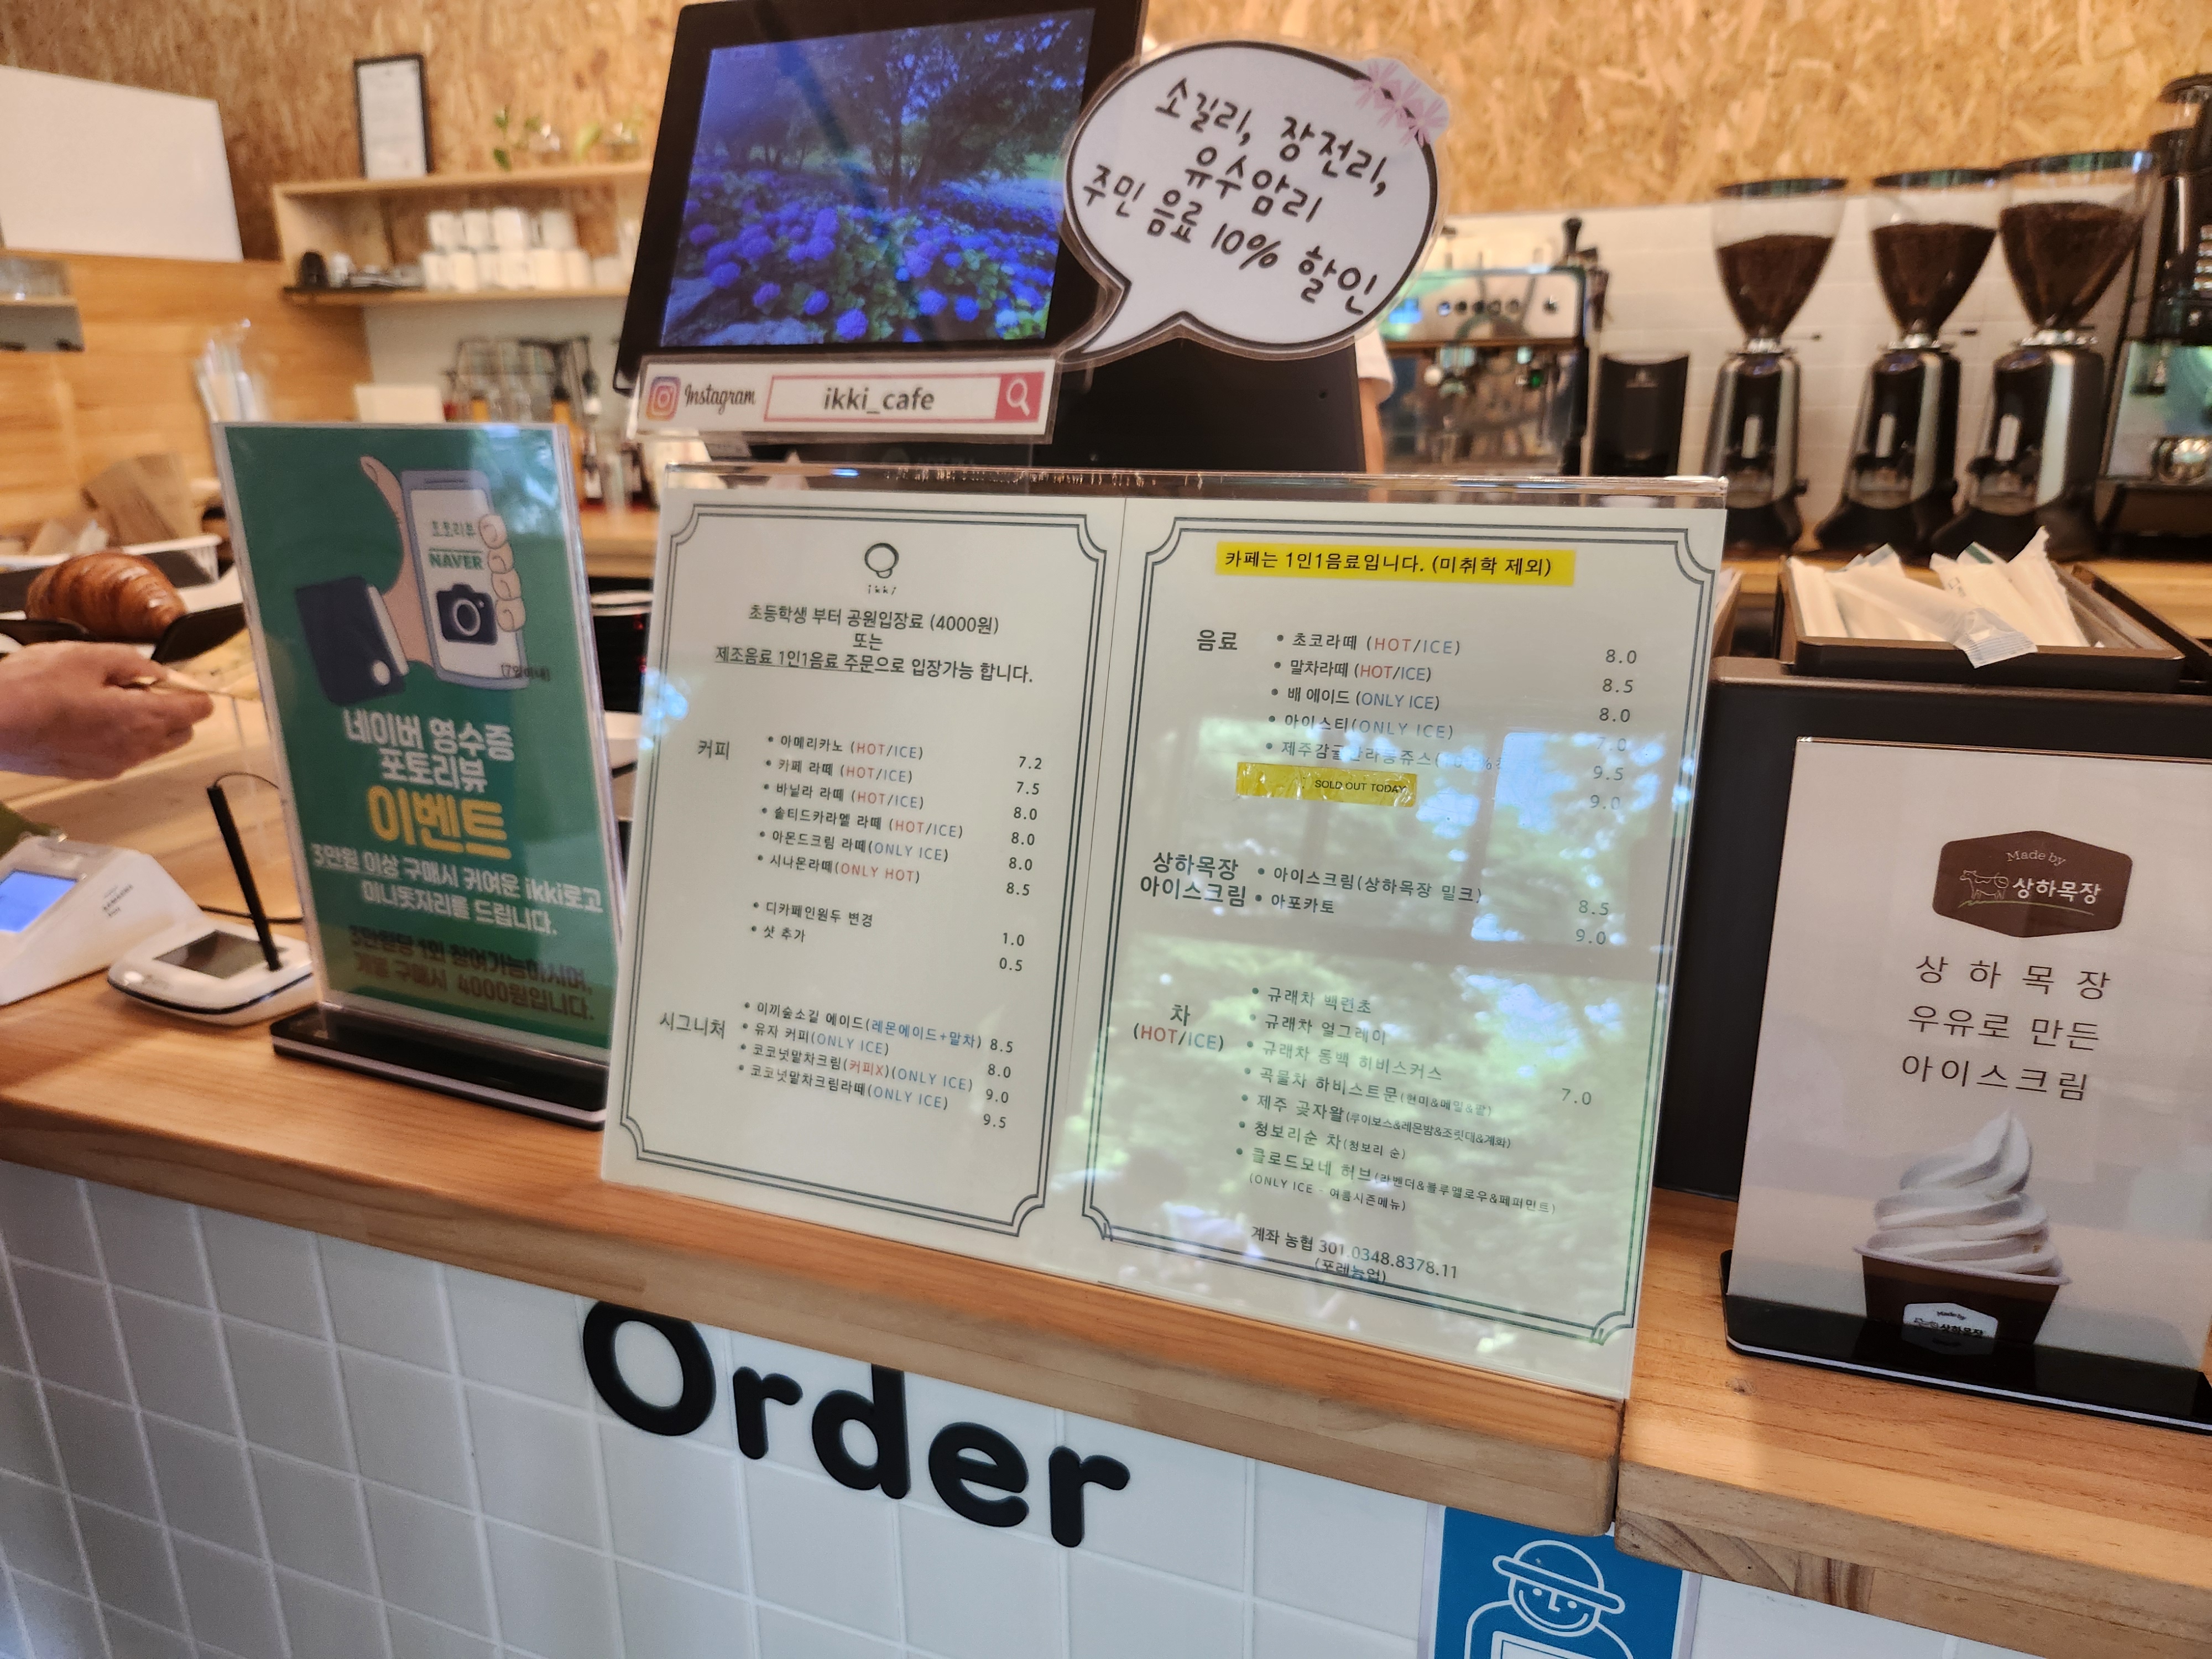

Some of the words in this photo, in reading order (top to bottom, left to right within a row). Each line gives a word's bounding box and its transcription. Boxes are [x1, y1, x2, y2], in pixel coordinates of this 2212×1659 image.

[1155, 78, 1251, 147] 소길리,
[1280, 116, 1388, 198] 장전리,
[1185, 146, 1323, 222] 유수암리
[1083, 164, 1145, 217] 주민
[1147, 189, 1203, 244] 음료
[1211, 223, 1282, 270] 10%
[1298, 246, 1378, 315] 할인
[685, 383, 756, 415] Instagram
[823, 386, 935, 415] ikki_cafe
[429, 554, 485, 570] NAVER
[1225, 551, 1279, 569] 카페는
[1286, 552, 1425, 574] 1인1음료입니다.
[1431, 555, 1496, 575] (미취학
[1505, 557, 1552, 577] 제외)
[749, 605, 806, 625] 초등학생
[812, 609, 841, 626] 부터
[847, 610, 924, 631] 공원입장료
[930, 615, 1000, 635] (4000원)
[853, 633, 883, 651] 또는
[1197, 629, 1238, 652] 음료
[1292, 632, 1357, 651] 초코라떼
[1366, 636, 1461, 656] (HOT/ICE)
[715, 646, 772, 666] 제조음료
[779, 650, 838, 670] 1인1음료
[844, 654, 905, 674] 주문으로
[912, 659, 973, 681] 입장가능
[980, 663, 1034, 684] 합니다.
[1605, 649, 1637, 665] 8.0
[1290, 659, 1349, 678] 말차라떼
[1354, 664, 1431, 683] (HOT/ICE)
[1602, 678, 1634, 694] 8.5
[1288, 687, 1301, 703] 배
[1307, 687, 1349, 706] 에이드
[1355, 691, 1404, 708] (ONLY
[1409, 694, 1440, 712] ICE)
[1599, 708, 1630, 723] 8.0
[343, 708, 424, 750] 네이버
[429, 717, 515, 762] 영수증
[1597, 736, 1627, 752] 7.0
[698, 740, 731, 760] 커피
[780, 734, 843, 753] 아메리카노
[850, 742, 923, 760] (HOT/ICE)
[379, 748, 488, 794] 포토리뷰
[779, 759, 802, 773] 카페
[808, 762, 833, 777] 라떼
[840, 765, 912, 784] (HOT/ICE)
[1019, 757, 1042, 770] 7.2
[1593, 765, 1624, 781] 9.5
[776, 782, 813, 799] 바닐라
[820, 787, 844, 802] 라떼
[851, 790, 924, 810] (HOT/ICE)
[1016, 781, 1040, 795] 7.5
[1314, 780, 1343, 791] SOLD
[1345, 780, 1368, 792] OUT
[1370, 782, 1407, 794] TODAY
[1013, 807, 1037, 820] 8.0
[1590, 794, 1621, 810] 9.0
[367, 785, 512, 859] 이벤트
[774, 806, 851, 827] 솔티드카라멜
[857, 815, 881, 831] 라떼
[889, 818, 963, 839] (HOT/ICE)
[773, 830, 834, 849] 아몬드크림
[919, 846, 948, 863] ICE)
[1011, 832, 1035, 846] 8.0
[1009, 857, 1032, 871] 8.0
[1152, 851, 1239, 881] 상하목장
[2006, 850, 2045, 863] Made
[2049, 852, 2066, 865] by
[311, 843, 358, 870] 3만원
[363, 851, 399, 879] 이상
[403, 855, 459, 888] 구매시
[464, 867, 519, 899] 귀여운
[525, 877, 603, 913] ikki로고
[885, 867, 920, 884] HOT)
[1006, 883, 1030, 896] 8.5
[1140, 875, 1246, 907] 아이스크림
[1442, 884, 1482, 904] 밀크)
[2013, 877, 2100, 905] 상하목장
[361, 880, 470, 920] 미니돗자리를
[475, 900, 557, 936] 드립니다.
[766, 901, 841, 924] 디카페인원두
[848, 911, 873, 928] 변경
[1271, 893, 1335, 915] 아포카토
[1579, 900, 1610, 916] 8.5
[764, 925, 775, 939] 샷
[781, 927, 806, 943] 추가
[1002, 933, 1025, 947] 1.0
[1575, 929, 1606, 946] 9.0
[999, 958, 1022, 972] 0.5
[1267, 987, 1315, 1007] 규래차
[1324, 994, 1371, 1014] 백련초
[757, 1001, 819, 1024] 이끼숲소길
[1169, 1004, 1191, 1027] 차
[660, 1012, 726, 1040] 시그니처
[1134, 1022, 1224, 1052] (HOT/ICE)
[1265, 1014, 1312, 1034] 규래차
[1322, 1021, 1386, 1045] 얼그레이
[1909, 1005, 2010, 1039] 우유로
[2032, 1018, 2099, 1051] 만든
[755, 1022, 778, 1039] 유자
[860, 1039, 889, 1056] ICE)
[989, 1039, 1014, 1053] 8.5
[988, 1063, 1011, 1078] 8.0
[1318, 1048, 1349, 1067] 동백
[1359, 1055, 1442, 1080] 히비스커스
[943, 1076, 973, 1093] ICE)
[1902, 1055, 2087, 1101] 아이스크림
[919, 1093, 948, 1110] ICE)
[986, 1089, 1009, 1103] 9.0
[1257, 1094, 1287, 1114] 제주
[1561, 1088, 1592, 1106] 7.0
[983, 1114, 1006, 1129] 9.5
[1255, 1121, 1317, 1146] 청보리순
[1252, 1147, 1332, 1176] 클로드모네
[1250, 1173, 1287, 1188] (ONLY
[1293, 1182, 1313, 1193] ICE
[1251, 1227, 1280, 1244] 계좌
[1285, 1233, 1313, 1251] 농협
[1318, 1240, 1457, 1279] 301.0348.8378.11
[582, 1300, 1131, 1547] Order
